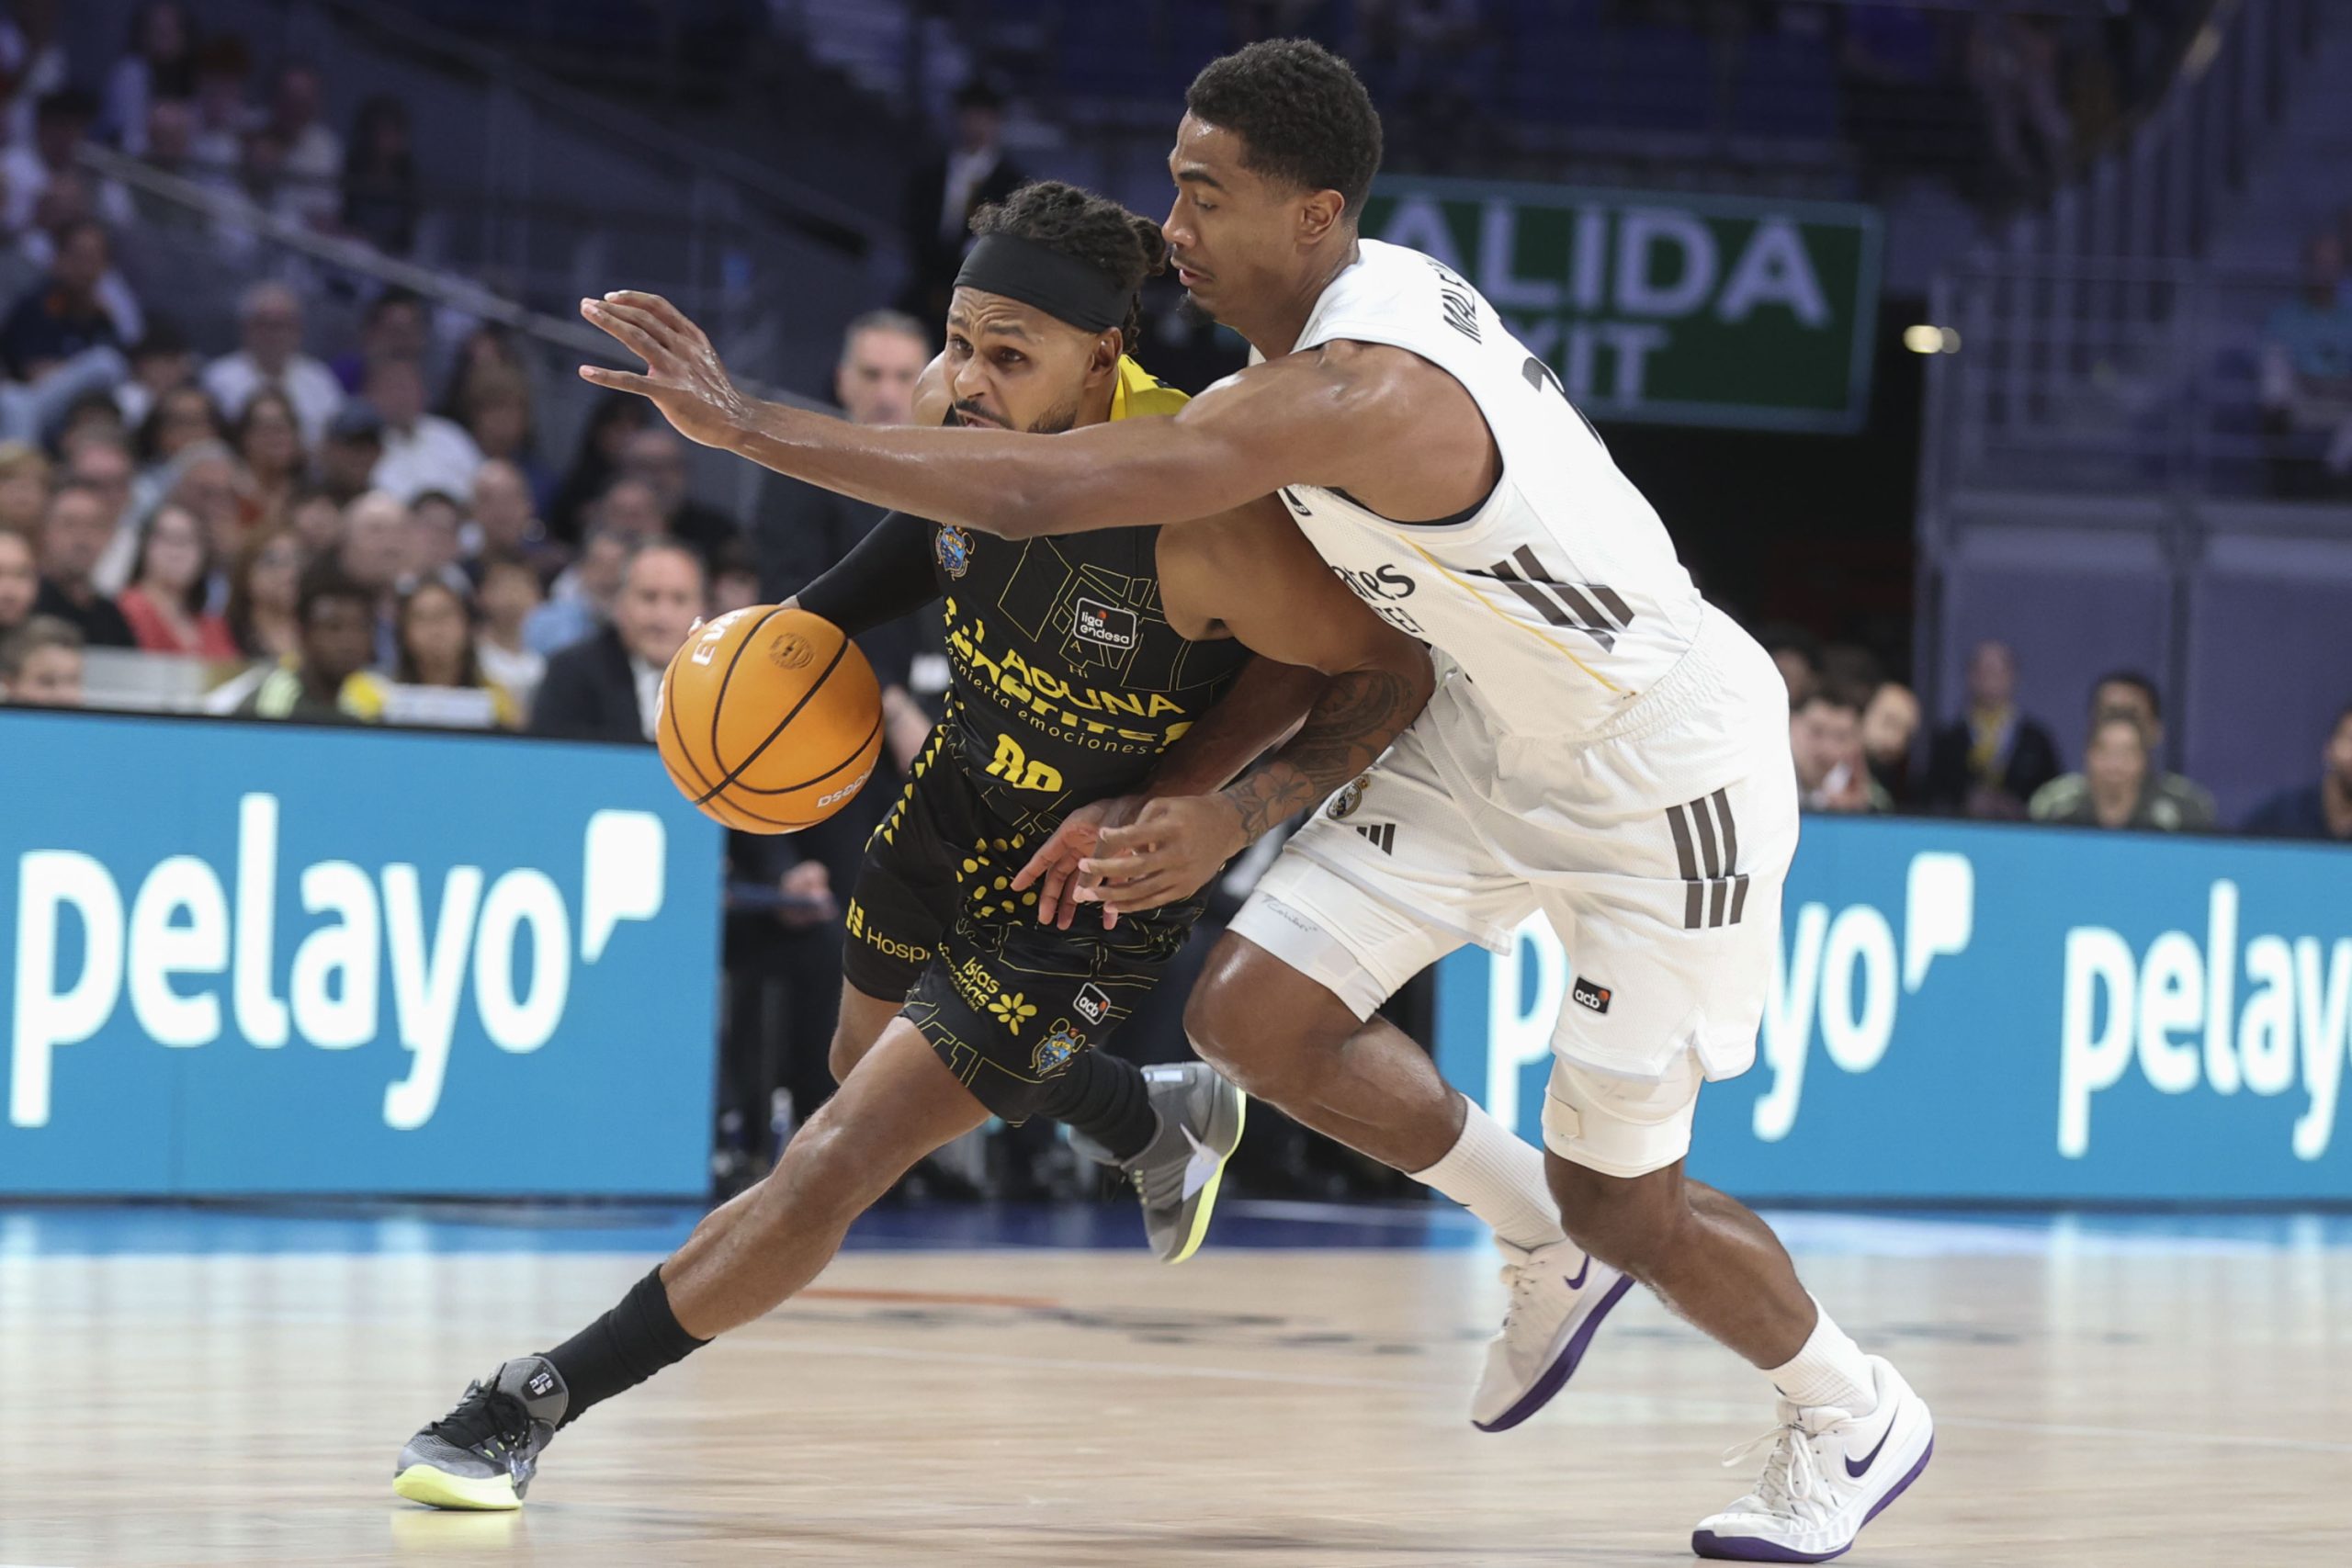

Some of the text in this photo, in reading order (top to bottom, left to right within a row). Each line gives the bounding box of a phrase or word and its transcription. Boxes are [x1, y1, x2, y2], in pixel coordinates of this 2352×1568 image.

[1080, 611, 1104, 628] liga
[1080, 624, 1130, 644] endesa
[8, 790, 572, 1131] pelayo
[962, 956, 1001, 994] Islas
[1079, 996, 1100, 1017] acb
[1575, 988, 1600, 1009] acb
[2057, 877, 2352, 1161] pelay
